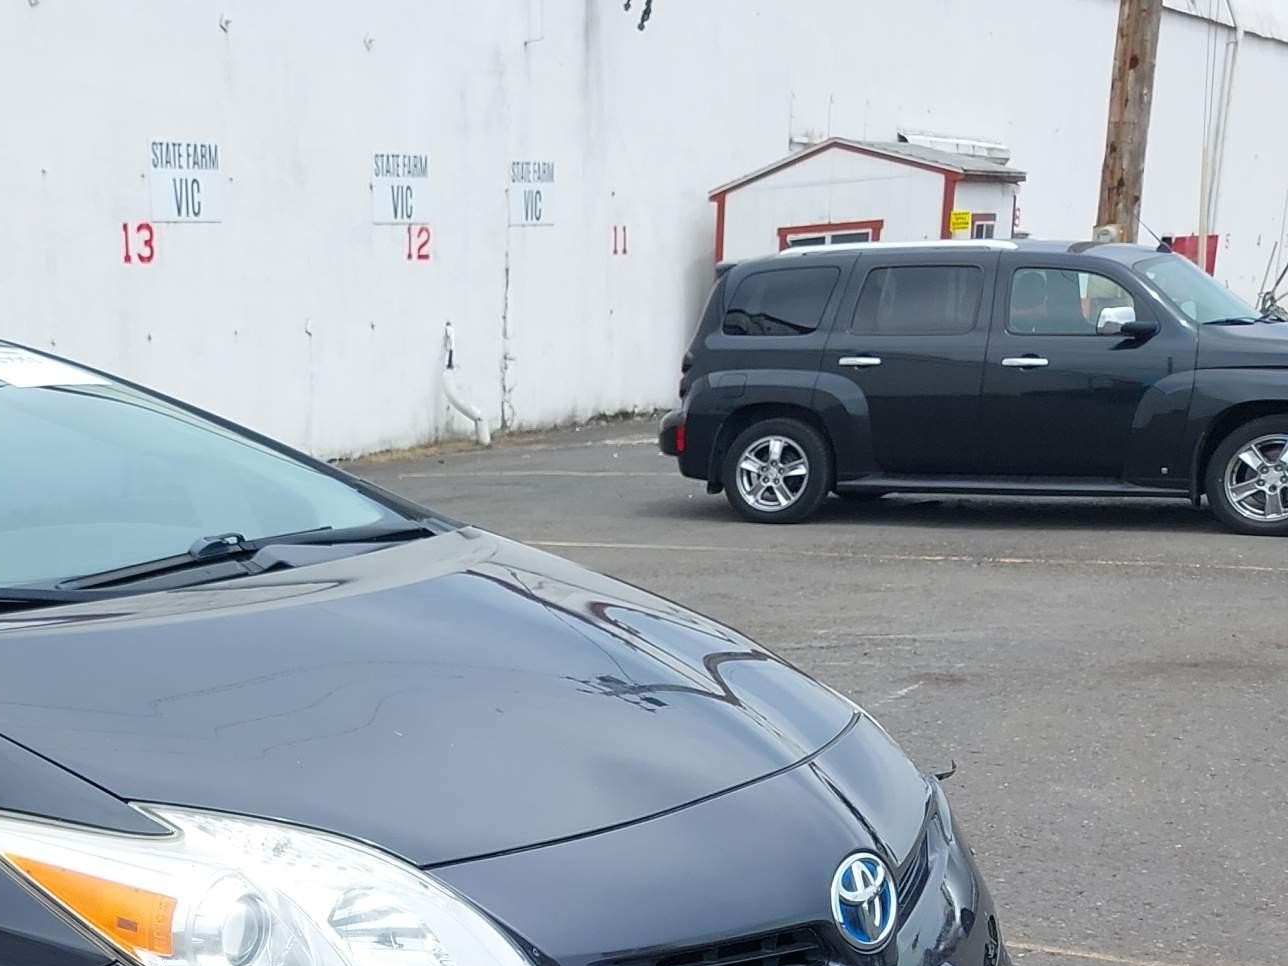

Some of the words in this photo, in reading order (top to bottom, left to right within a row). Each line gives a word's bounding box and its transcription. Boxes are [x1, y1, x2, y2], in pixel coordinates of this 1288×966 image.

[151, 141, 183, 169] STATE
[186, 143, 219, 170] FARM
[374, 154, 400, 178] STATE
[402, 155, 428, 178] FARM
[511, 161, 531, 183] STATE
[532, 162, 554, 183] FARM
[172, 178, 201, 217] VIC
[391, 185, 414, 220] VIC
[523, 190, 542, 221] VIC
[122, 222, 155, 264] 13
[406, 226, 431, 260] 12
[612, 225, 628, 255] 11
